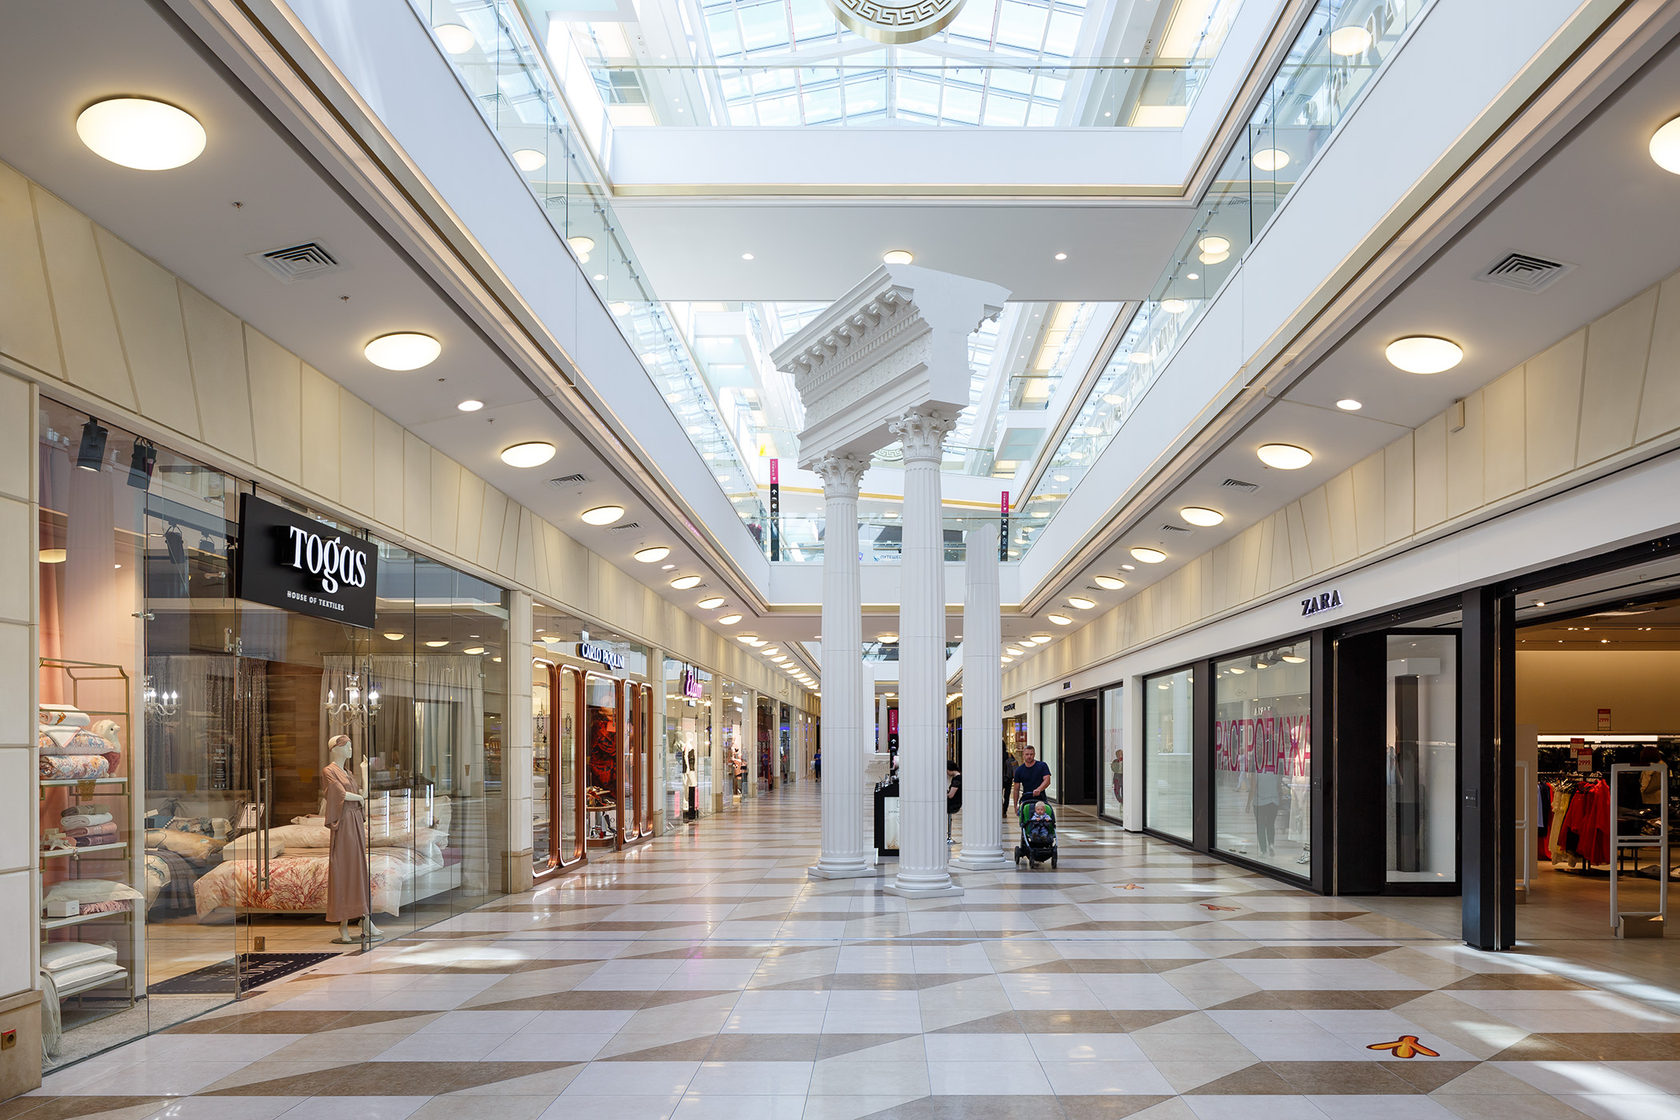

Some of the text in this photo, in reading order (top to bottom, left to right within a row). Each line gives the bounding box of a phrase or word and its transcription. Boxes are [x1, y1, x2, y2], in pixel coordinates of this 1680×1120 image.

[290, 525, 366, 593] Togas
[287, 590, 345, 612] HOUSE OF TEXTILES
[1301, 589, 1343, 617] ZARA
[582, 643, 602, 663] CARLO
